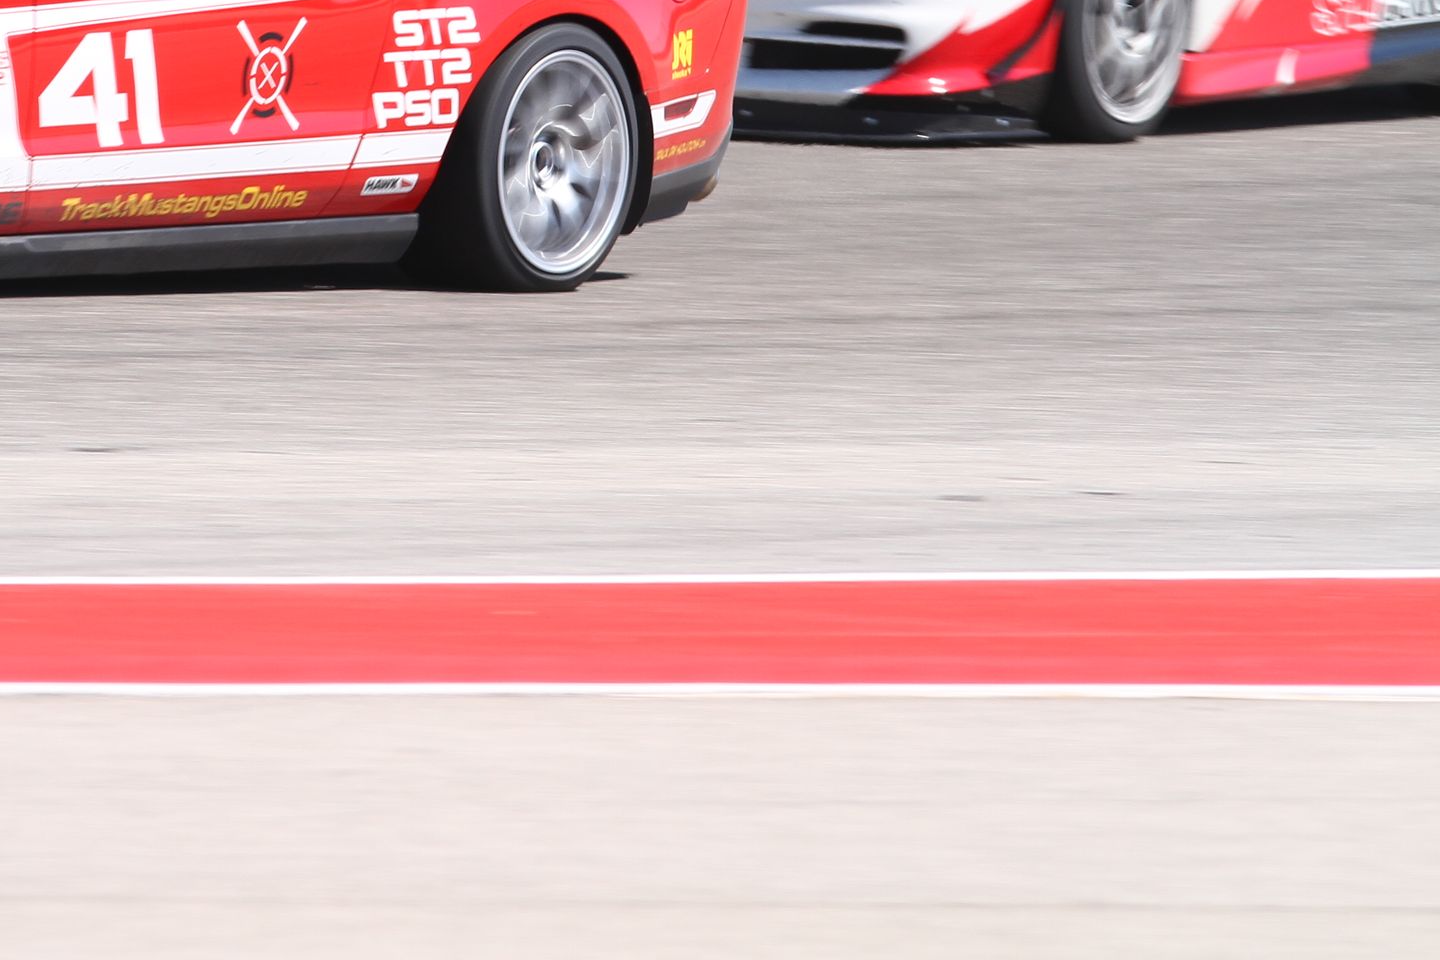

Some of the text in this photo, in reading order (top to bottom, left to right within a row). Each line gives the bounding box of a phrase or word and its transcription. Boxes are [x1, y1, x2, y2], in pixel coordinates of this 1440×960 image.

[393, 6, 481, 47] ST2
[38, 28, 165, 147] 41
[383, 47, 472, 88] TT2
[60, 185, 309, 222] TrackMustangsOnline
